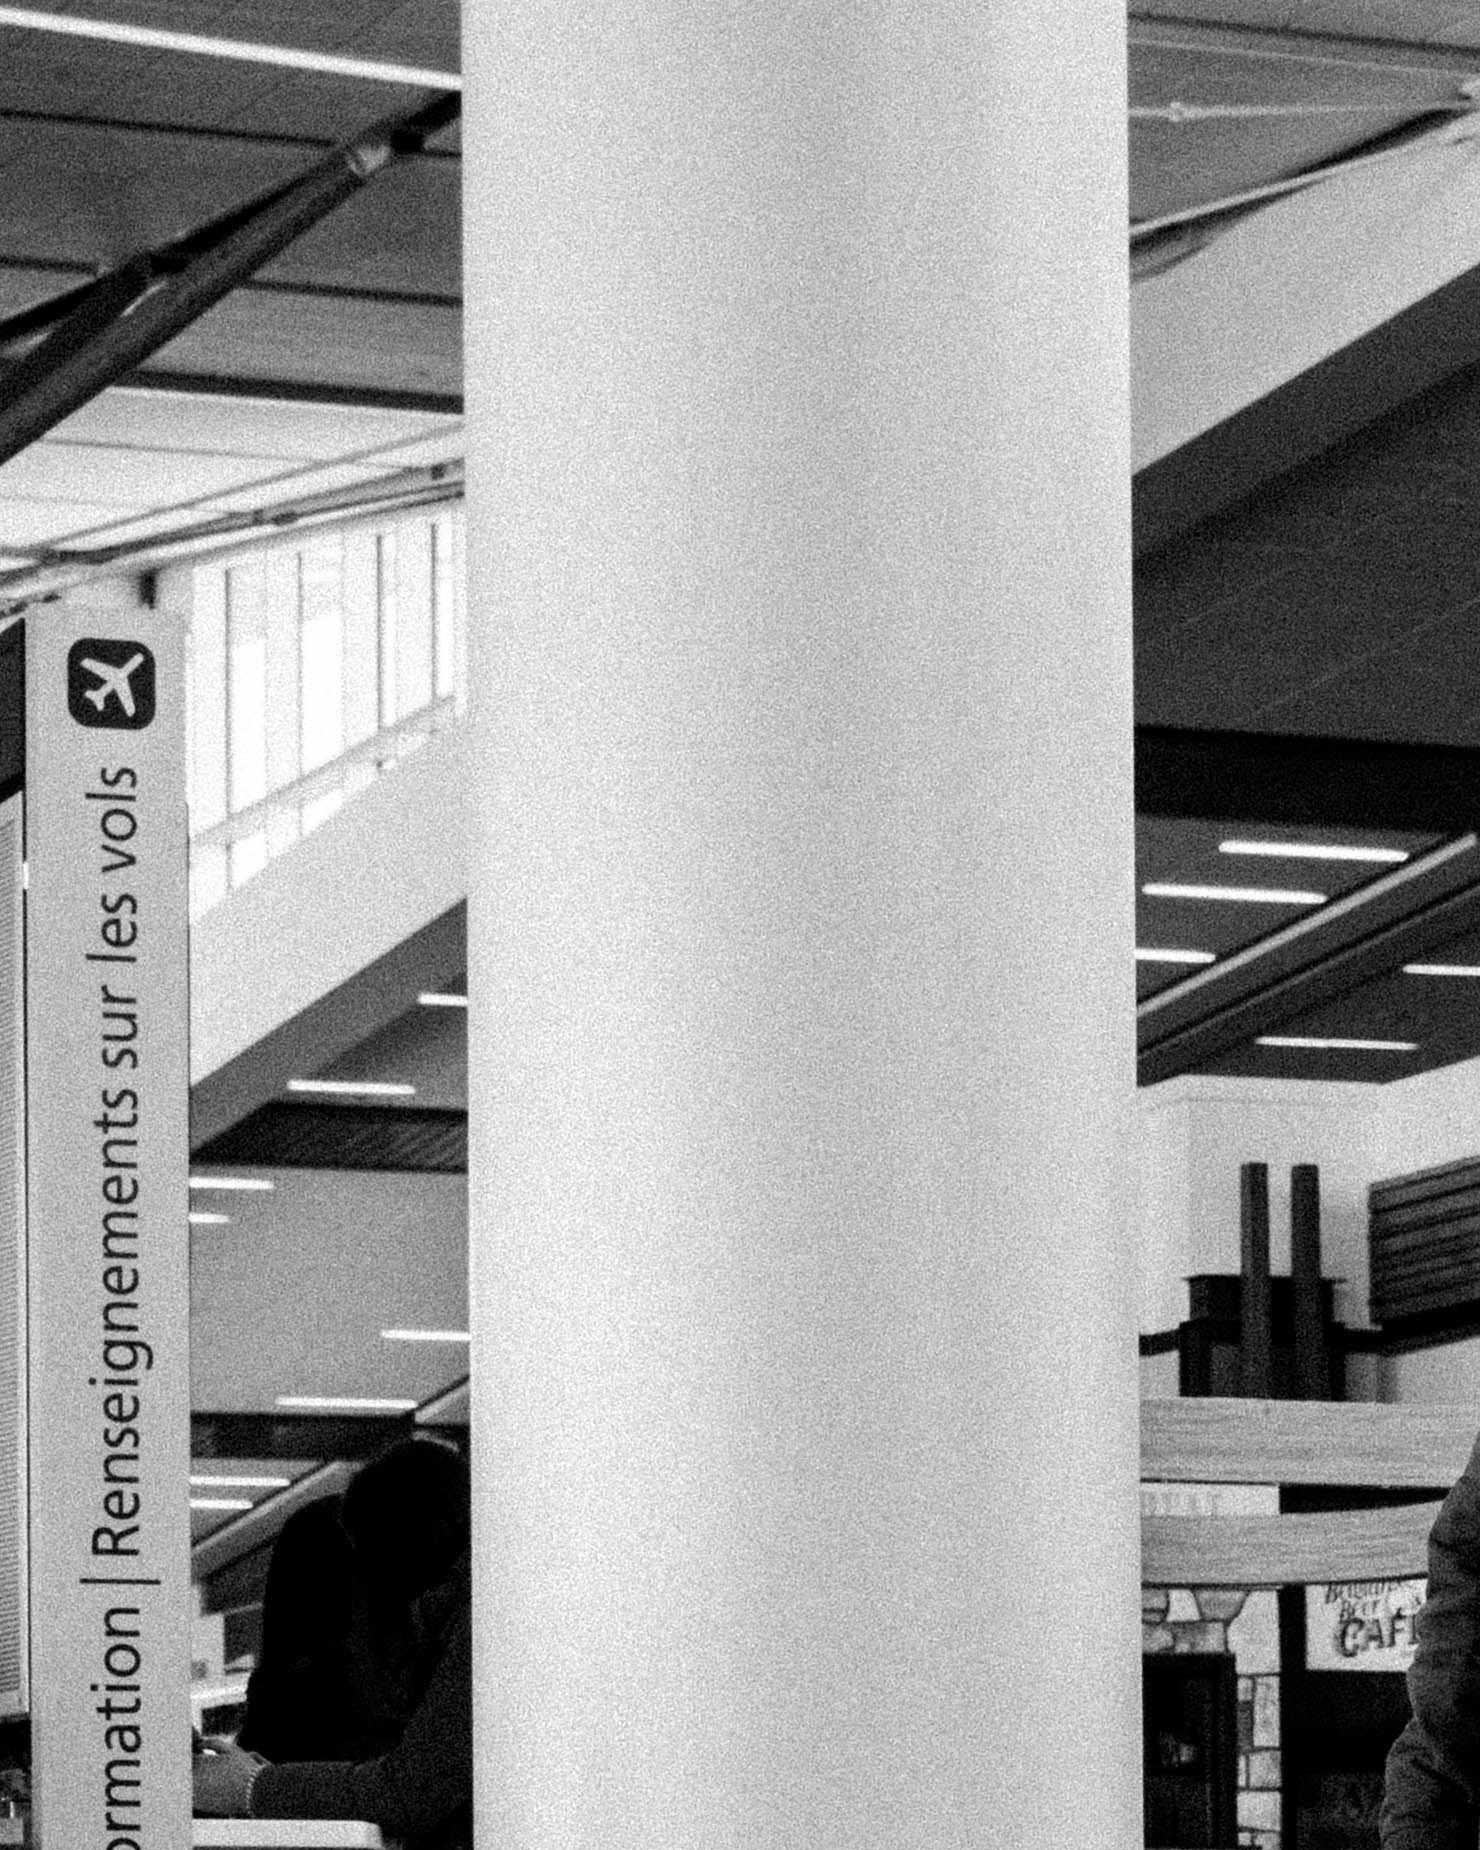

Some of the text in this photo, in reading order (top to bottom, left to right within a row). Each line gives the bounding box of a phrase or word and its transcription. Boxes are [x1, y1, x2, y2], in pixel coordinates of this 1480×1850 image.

[84, 766, 138, 873] vols
[85, 892, 138, 963] les
[101, 984, 139, 1069] sur
[89, 1087, 155, 1558] Renseignements
